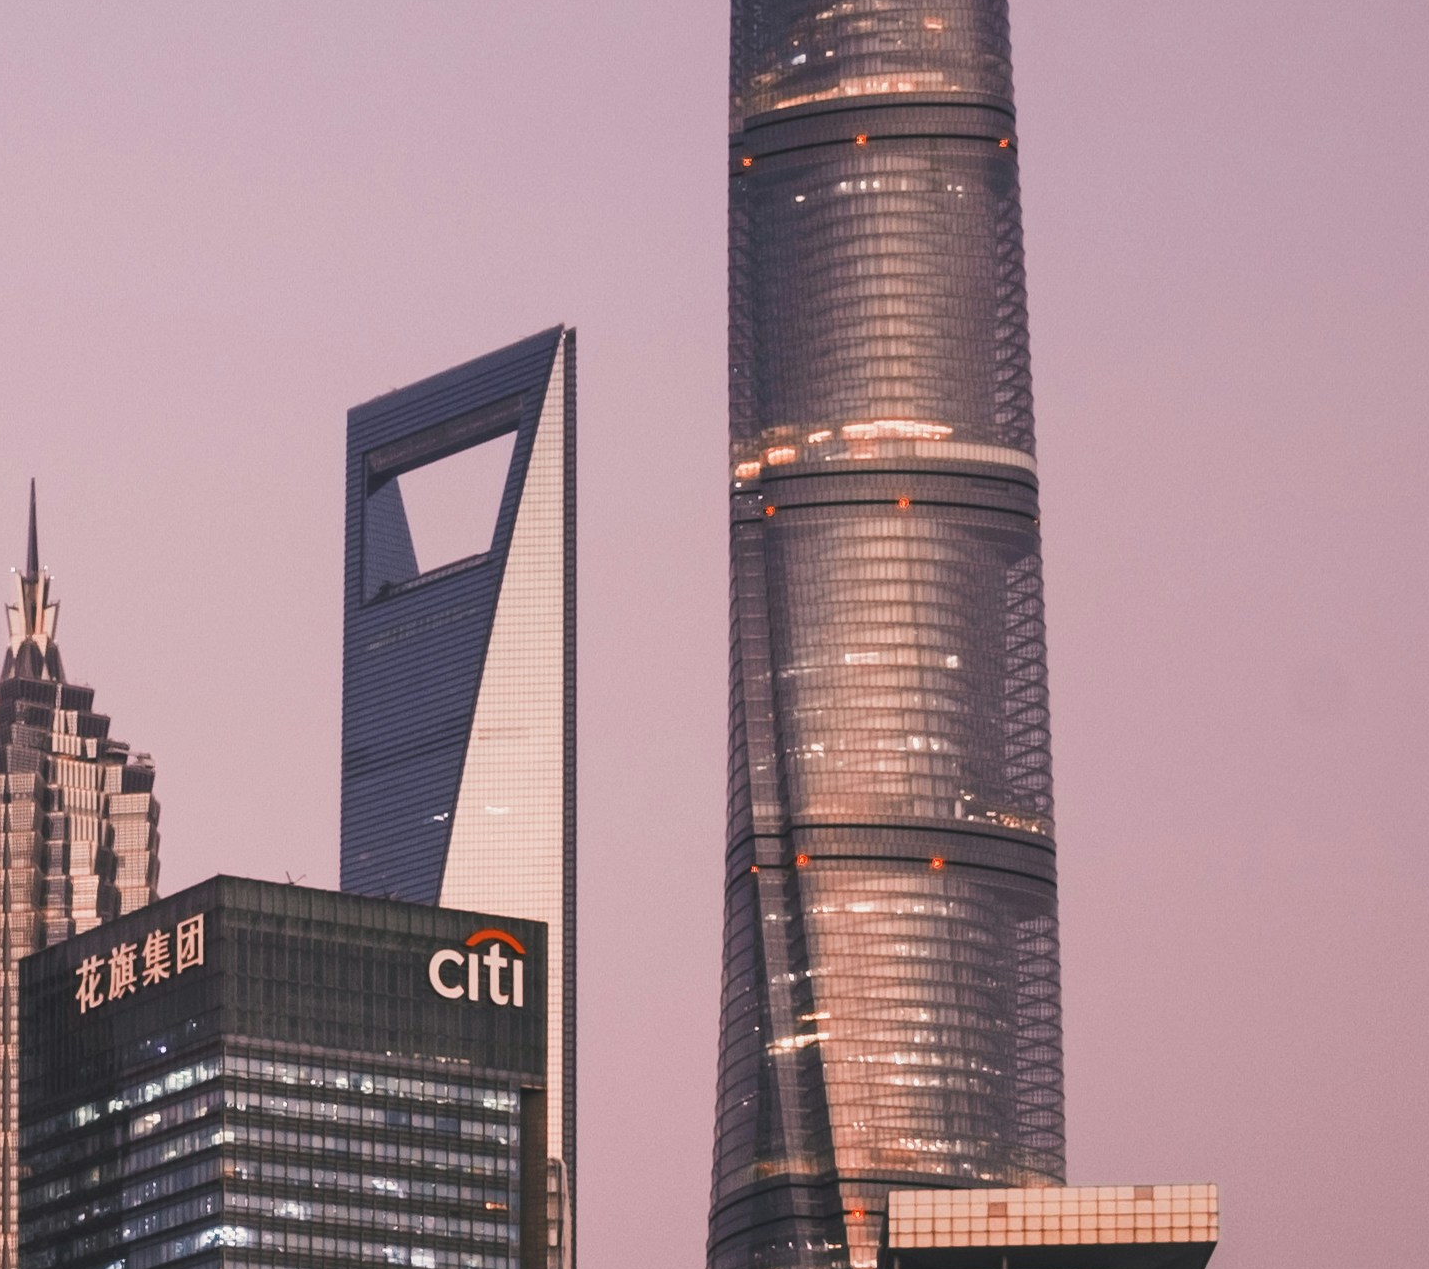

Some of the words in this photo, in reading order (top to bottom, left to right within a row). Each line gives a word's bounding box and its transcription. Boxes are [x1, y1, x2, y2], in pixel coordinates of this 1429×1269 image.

[75, 913, 204, 1014] 花旗集团
[429, 942, 523, 1007] citi
